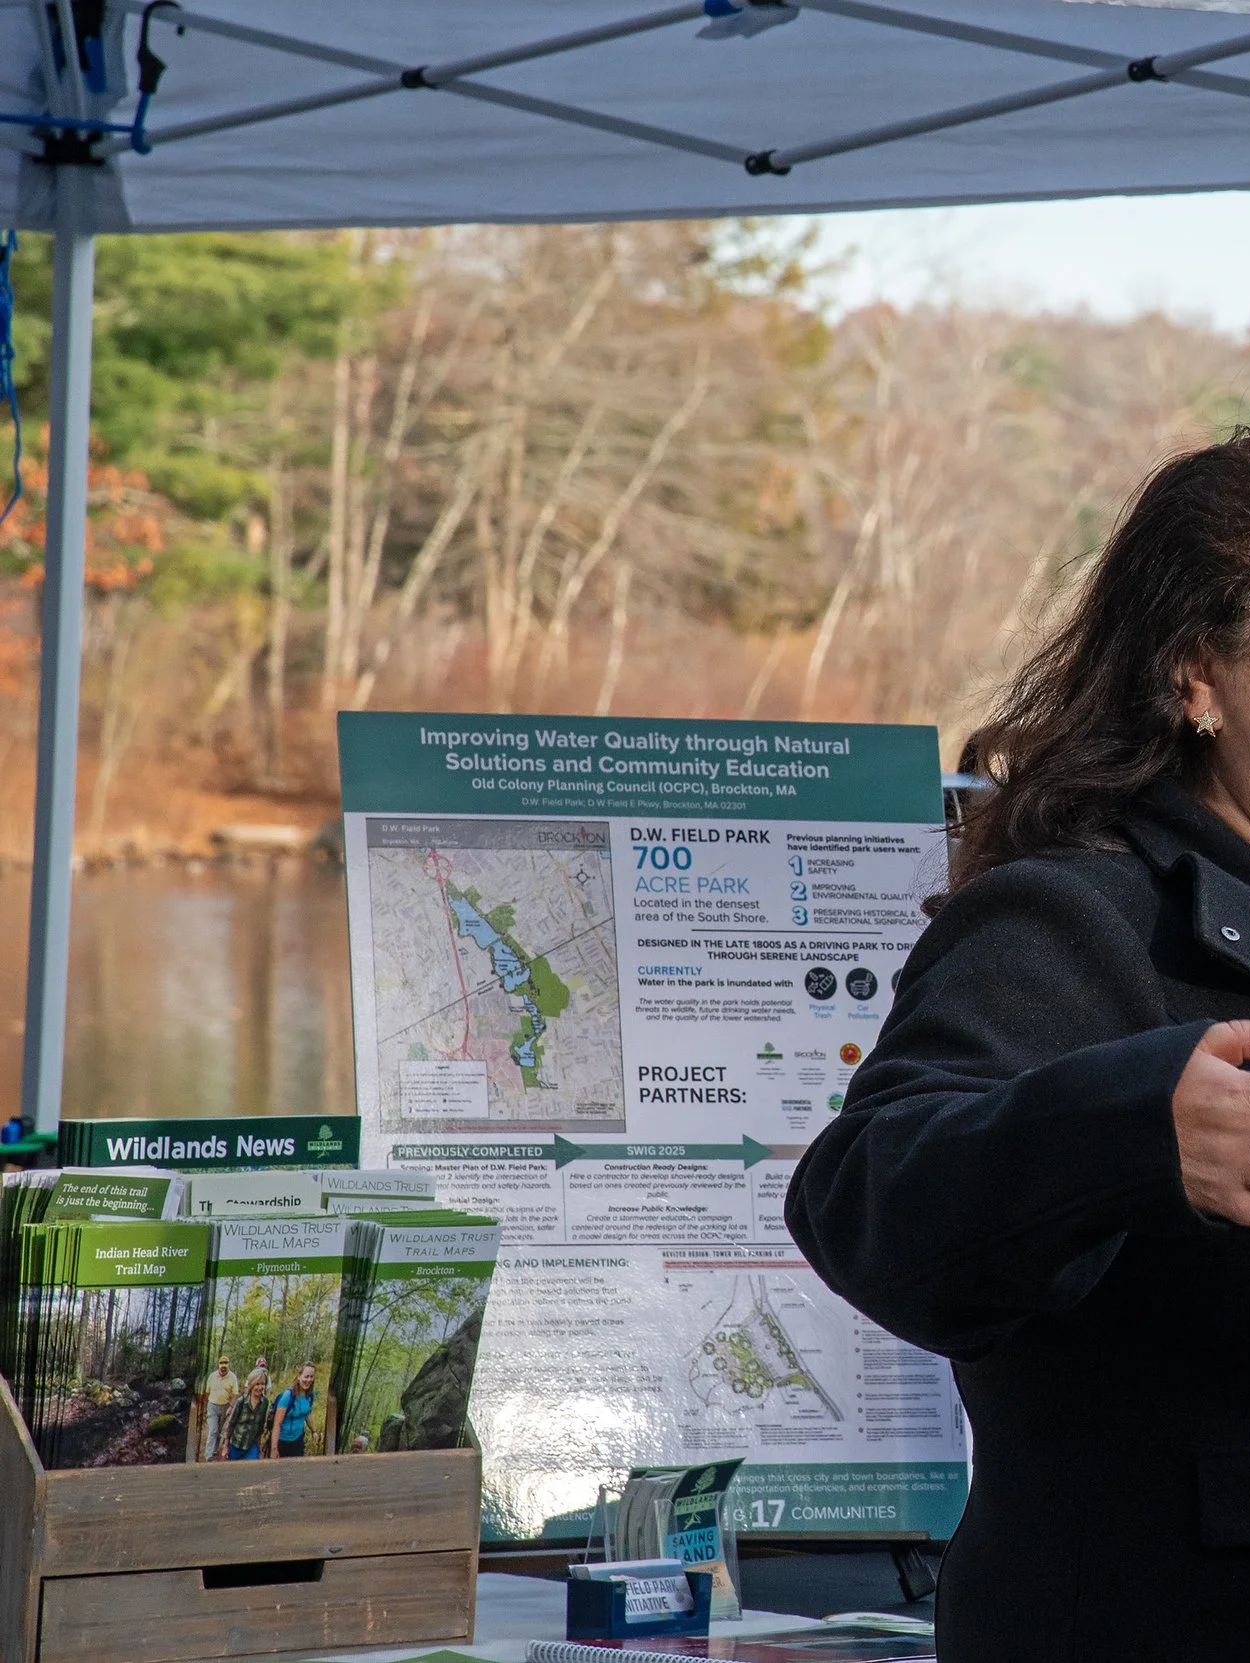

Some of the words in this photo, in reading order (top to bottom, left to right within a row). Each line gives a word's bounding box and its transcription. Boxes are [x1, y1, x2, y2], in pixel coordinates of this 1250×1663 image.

[420, 727, 529, 750] Improving
[535, 730, 598, 748] Water
[604, 731, 680, 754] Quality
[685, 734, 768, 756] through
[774, 736, 850, 755] Natural
[446, 752, 546, 771] Solutions
[553, 756, 592, 773] and
[599, 756, 720, 779] Community
[726, 759, 830, 778] Education
[472, 778, 495, 789] Old
[499, 778, 544, 793] Colony
[548, 780, 604, 794] Planning
[607, 780, 656, 793] Council
[659, 781, 709, 795] (OCPC),
[711, 783, 773, 797] Brockton,
[776, 785, 797, 796] MA
[543, 798, 563, 806] Field
[608, 799, 627, 808] Field
[704, 801, 718, 809] MA
[721, 802, 746, 810] 02301
[401, 824, 421, 832] Field
[423, 825, 440, 833] Park
[630, 827, 667, 841] D.W.
[672, 828, 720, 842] FIELD
[726, 829, 770, 844] PARK
[786, 833, 824, 842] Previous
[826, 834, 862, 844] planning
[864, 835, 905, 844] initiatives
[787, 843, 808, 851] have
[810, 843, 850, 852] identified
[852, 844, 871, 853] park
[873, 845, 896, 853] users
[897, 846, 921, 854] want:
[632, 845, 692, 870] 700
[807, 859, 855, 867] INCREASING
[788, 854, 803, 876] 1
[808, 866, 838, 875] SAFETY
[635, 876, 690, 893] ACRE
[697, 876, 750, 894] PARK
[790, 880, 807, 901] 2
[812, 883, 856, 891] IMPROVING
[812, 892, 878, 900] ENVIRONMENTAL
[880, 893, 914, 901] QUALITY
[633, 897, 678, 908] Located
[682, 898, 692, 908] in
[695, 899, 712, 909] the
[716, 899, 760, 909] densest
[634, 913, 659, 922] area
[663, 912, 674, 922] of
[677, 912, 695, 922] the
[697, 912, 730, 923] South
[733, 912, 769, 923] Shore.
[792, 905, 808, 926] 3
[813, 908, 862, 916] PRESERVING
[863, 909, 909, 918] HISTORICAL
[814, 916, 872, 925] RECREATIONAL
[637, 939, 688, 948] DESIGNED
[691, 939, 701, 948] IN
[704, 939, 723, 948] THE
[725, 940, 750, 948] LATE
[752, 940, 781, 949] 1800S
[784, 941, 797, 949] AS
[800, 941, 807, 949] A
[809, 941, 850, 950] DRIVING
[852, 942, 878, 950] PARK
[881, 942, 894, 950] TO
[707, 951, 758, 960] THROUGH
[760, 952, 798, 961] SERENE
[800, 953, 859, 962] LANDSCAPE
[637, 965, 703, 976] CURRENTLY
[637, 978, 665, 986] Water
[667, 978, 676, 986] in
[678, 978, 693, 987] the
[695, 979, 715, 988] park
[717, 979, 725, 987] is
[727, 979, 772, 988] inundated
[774, 980, 793, 988] with
[638, 1066, 727, 1082] PROJECT
[639, 1088, 747, 1104] PARTNERS:
[106, 1135, 228, 1161] Wildlands
[236, 1135, 295, 1157] News
[397, 1147, 470, 1158] PREVIOUSLY
[472, 1146, 543, 1157] COMPLETED
[626, 1146, 656, 1156] SWIG
[658, 1146, 686, 1156] 2025
[481, 1163, 489, 1171] of
[653, 1164, 676, 1172] Ready
[678, 1164, 709, 1172] Designs:
[62, 1183, 78, 1193] The
[80, 1184, 97, 1193] end
[99, 1184, 110, 1195] of
[110, 1185, 127, 1195] this
[129, 1186, 148, 1197] trail
[327, 1177, 391, 1191] WILDLANDS
[394, 1180, 430, 1193] TRUST
[56, 1195, 65, 1204] is
[64, 1196, 84, 1207] just
[86, 1197, 101, 1207] the
[102, 1198, 155, 1212] beginning...
[608, 1205, 640, 1213] Increase
[641, 1205, 664, 1213] Public
[224, 1223, 299, 1236] WILDLANDS
[301, 1222, 341, 1234] TRUST
[242, 1237, 279, 1250] TRAIL
[282, 1237, 320, 1249] MAPS
[390, 1233, 457, 1243] WILDLANDS
[461, 1232, 496, 1242] TRUST
[95, 1247, 130, 1259] Indian
[132, 1246, 159, 1258] Head
[161, 1246, 189, 1257] River
[405, 1247, 439, 1256] TRAIL
[443, 1246, 476, 1256] MAPS
[257, 1262, 301, 1275] Plymouth
[514, 1258, 539, 1268] AND
[542, 1258, 630, 1268] IMPLEMENTING:
[115, 1263, 141, 1275] Trail
[143, 1264, 166, 1277] Map
[416, 1266, 455, 1275] Brockton
[768, 1473, 785, 1482] that
[787, 1474, 812, 1482] cross
[814, 1472, 829, 1484] city
[832, 1472, 849, 1481] and
[851, 1473, 873, 1481] town
[930, 1471, 945, 1480] like
[849, 1483, 865, 1492] and
[867, 1483, 909, 1492] economic
[751, 1499, 785, 1528] 17
[791, 1505, 896, 1520] COMMUNITIES
[672, 1530, 714, 1548] SAVING
[653, 1577, 678, 1594] PARK
